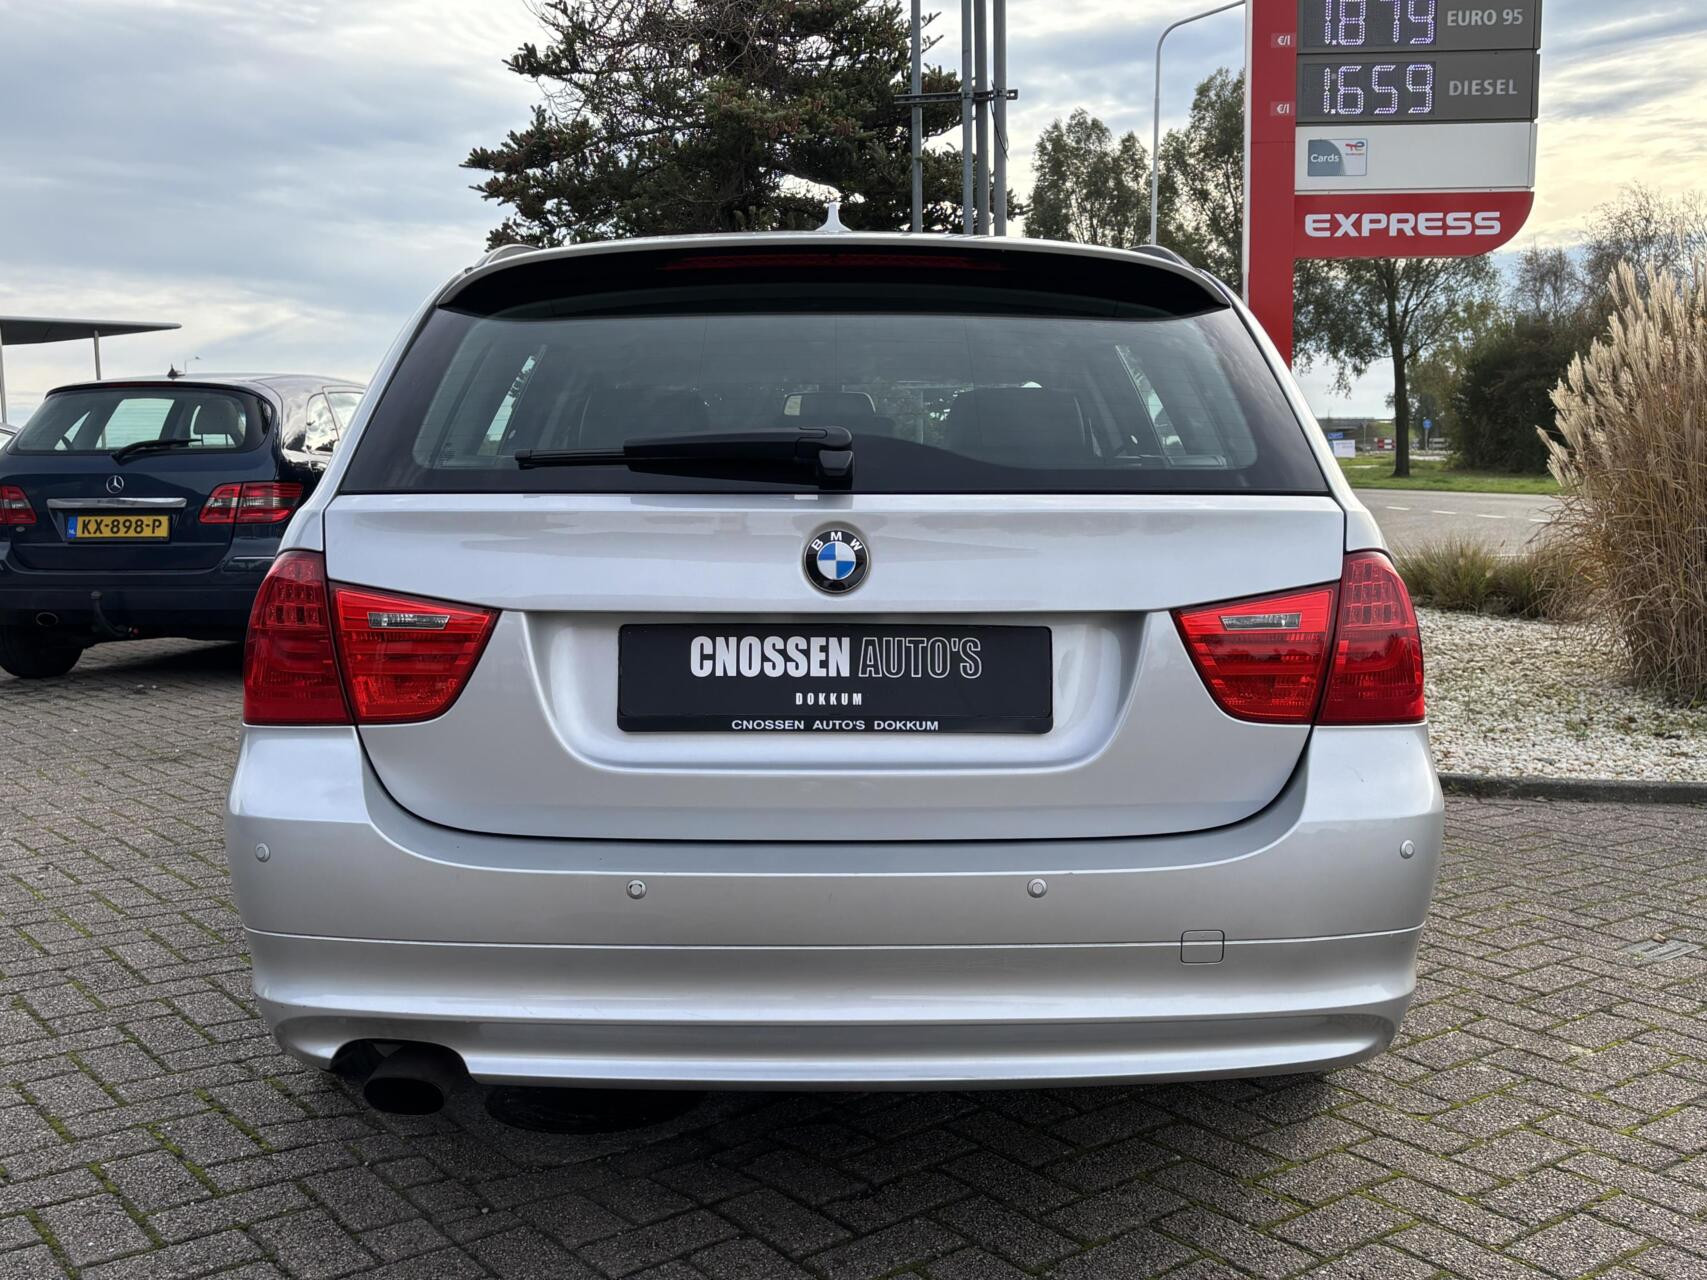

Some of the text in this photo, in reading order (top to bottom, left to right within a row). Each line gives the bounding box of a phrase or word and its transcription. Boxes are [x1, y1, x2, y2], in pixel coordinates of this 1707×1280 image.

[1325, 0, 1523, 45] 1.879 EURO 95
[1323, 64, 1518, 115] 1.659 DIESEL
[1310, 153, 1340, 163] Cards
[1304, 211, 1501, 238] EXPRESS
[81, 518, 162, 535] KX-898-P
[811, 531, 863, 551] BMW
[690, 635, 983, 679] CNOSSEN AUTO'S
[795, 692, 863, 706] DOKKUM
[731, 719, 939, 731] CNOSSEN AUTO'S DOKKUM
